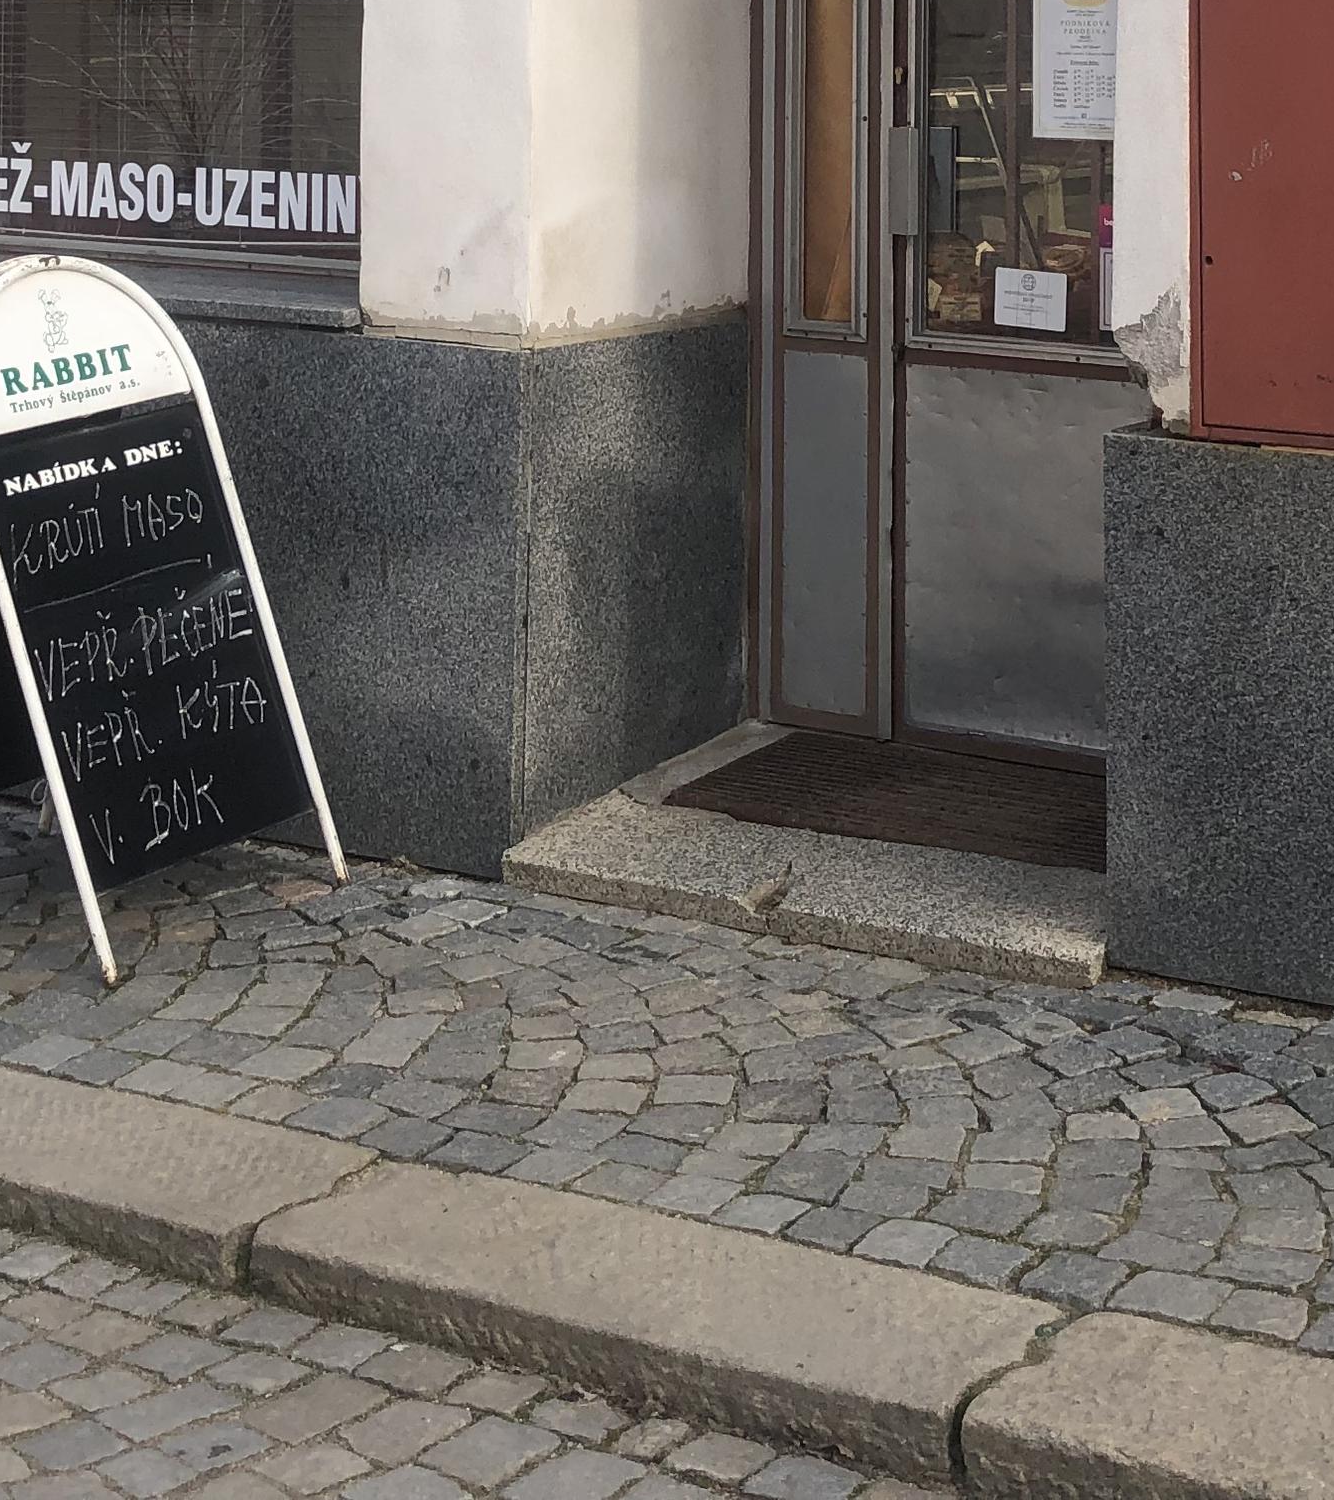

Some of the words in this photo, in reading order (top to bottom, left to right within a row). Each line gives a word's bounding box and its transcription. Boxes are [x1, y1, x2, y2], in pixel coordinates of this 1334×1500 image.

[0, 344, 132, 396] RABBIT
[9, 395, 55, 414] Trhový
[59, 384, 113, 404] Štěpánov
[119, 378, 141, 390] a.s.
[123, 439, 183, 467] DNE:
[121, 488, 204, 547] MASO
[89, 808, 124, 865] V.
[139, 766, 225, 851] BOK
